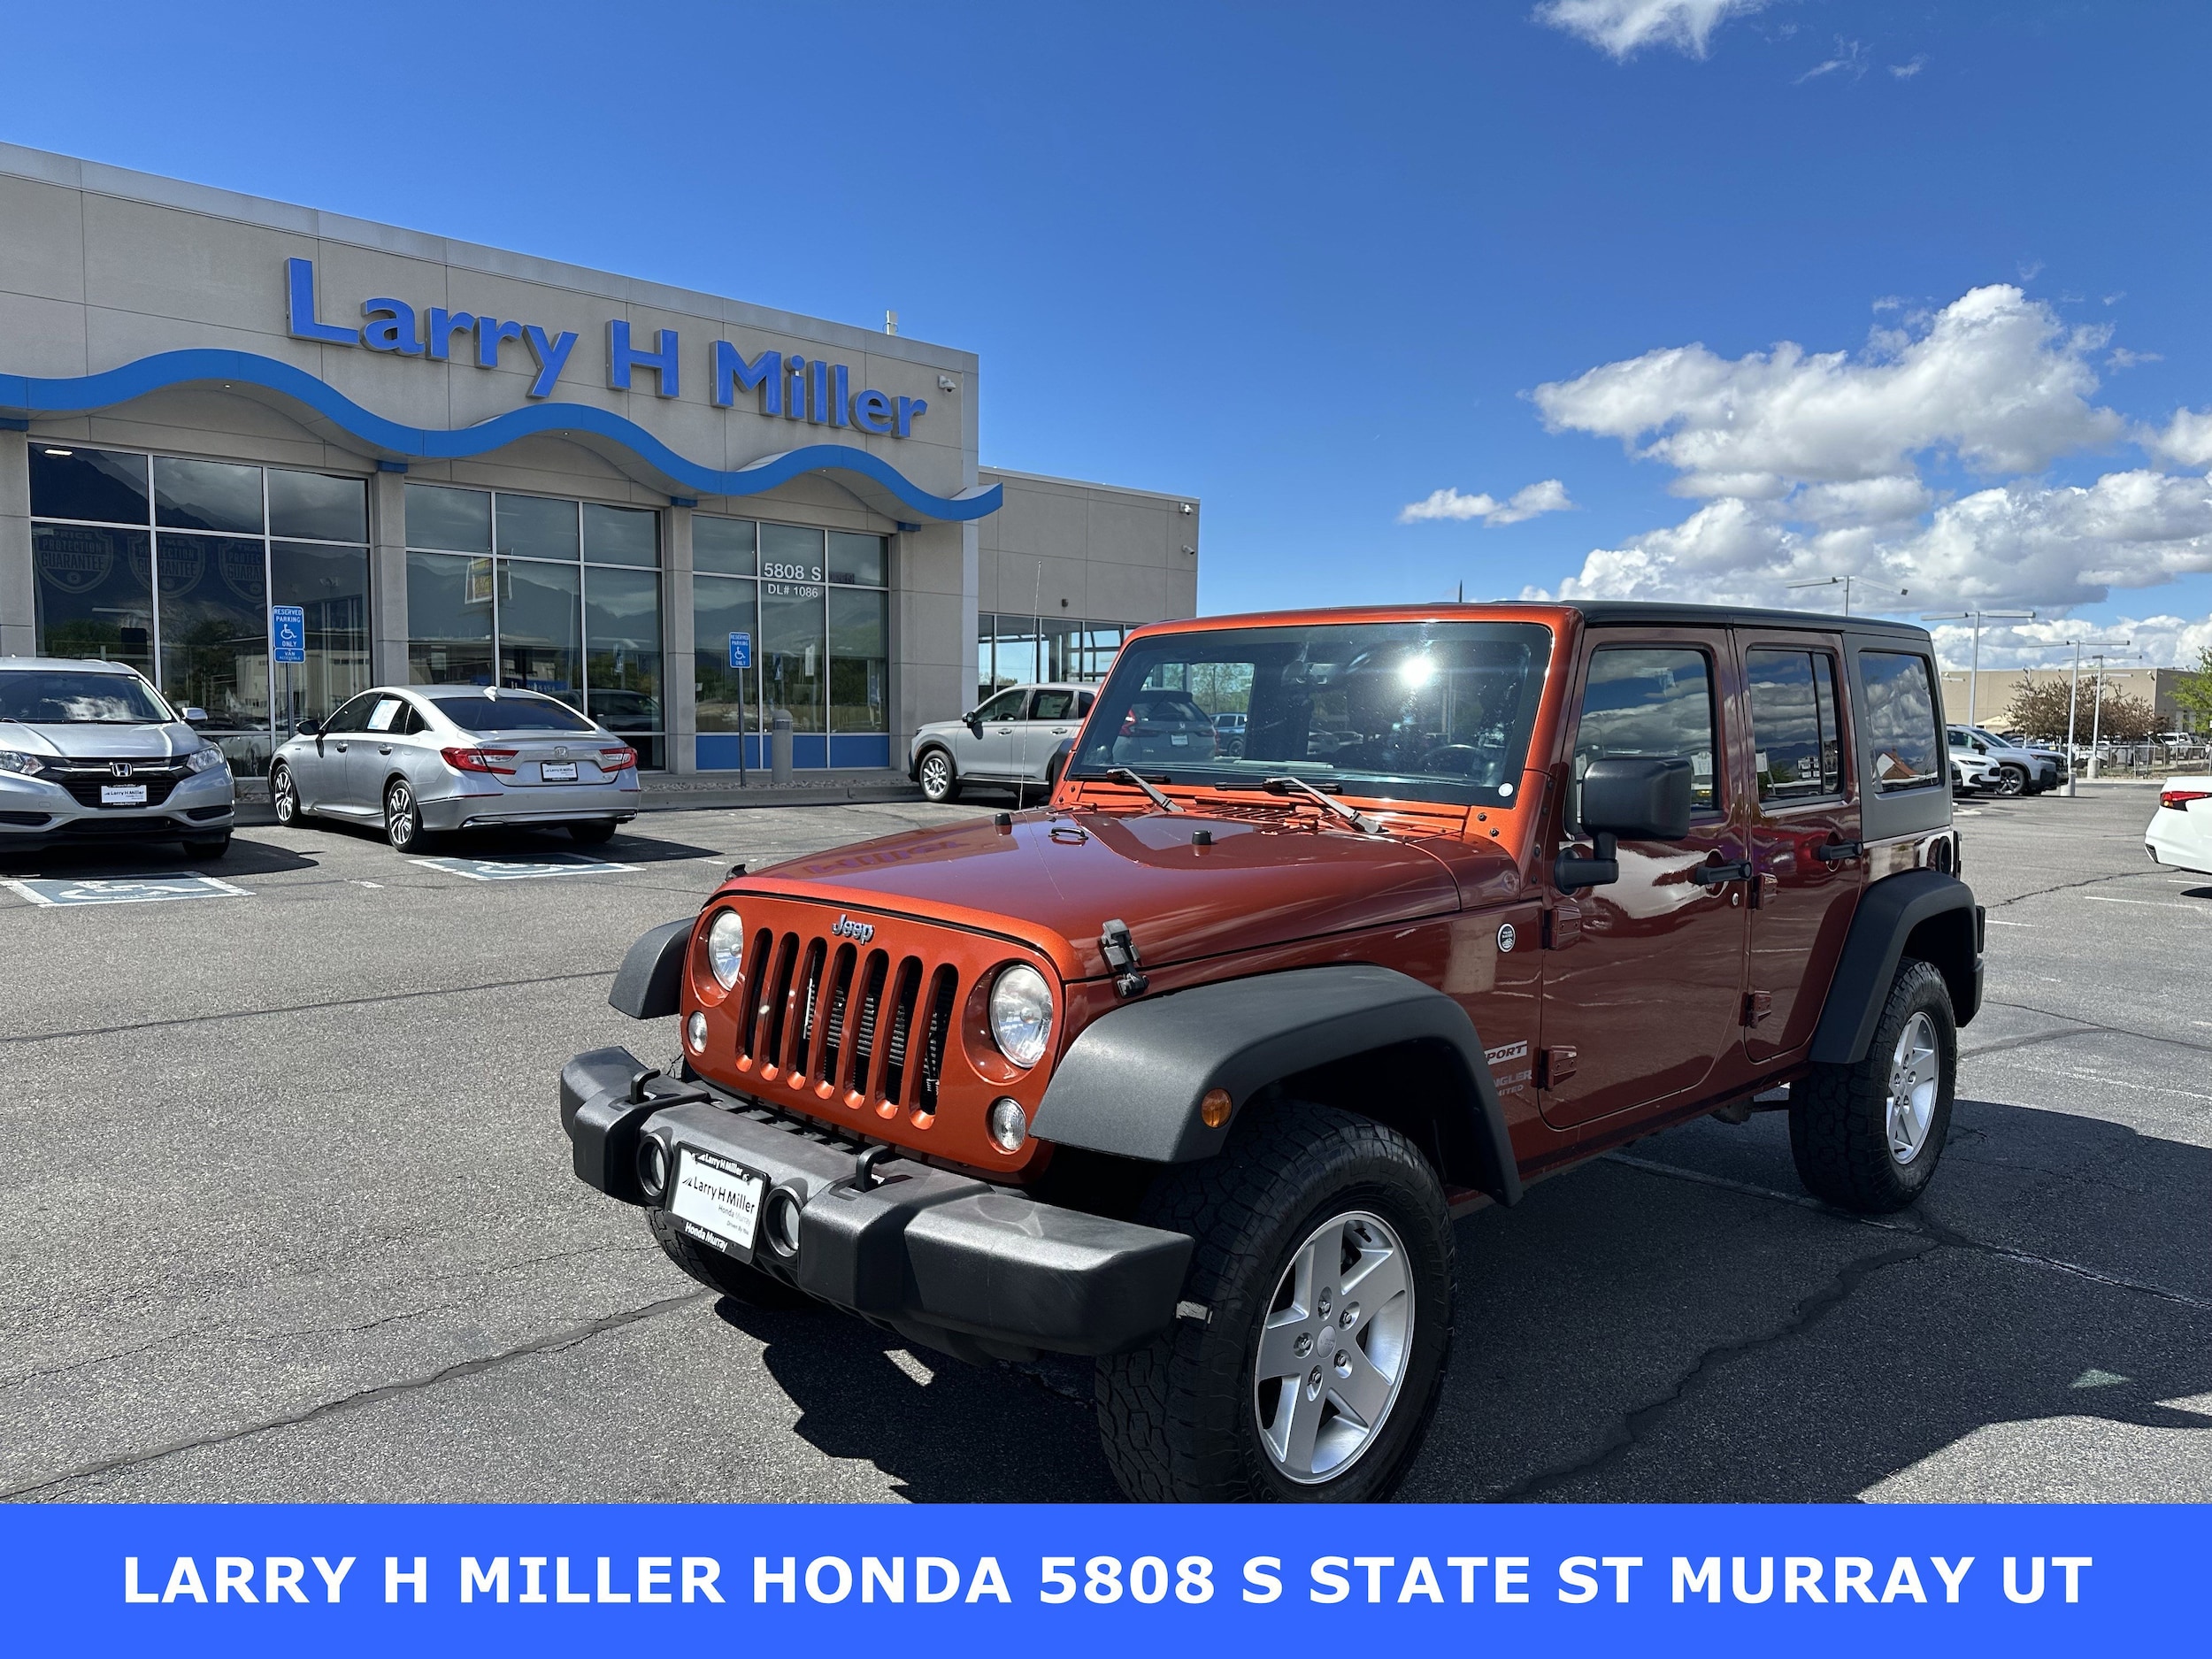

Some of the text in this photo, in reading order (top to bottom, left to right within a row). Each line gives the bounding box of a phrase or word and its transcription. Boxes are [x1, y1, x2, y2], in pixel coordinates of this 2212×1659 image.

[285, 257, 928, 438] Larry H Miller
[42, 538, 104, 554] PROTECTION
[158, 537, 185, 547] IME
[42, 552, 104, 571] GUARANTEE
[138, 546, 195, 560] PRTECTION
[137, 558, 196, 576] GURANTEE
[764, 563, 821, 580] 5808 S
[768, 584, 818, 598] DL# 1086
[832, 914, 875, 945] Jeep
[1486, 1044, 1527, 1062] PORT
[706, 1153, 743, 1176] Larry H Miller
[694, 1176, 755, 1214] Larry H Miller
[718, 1204, 734, 1217] Honda
[685, 1222, 728, 1253] Honda Murray
